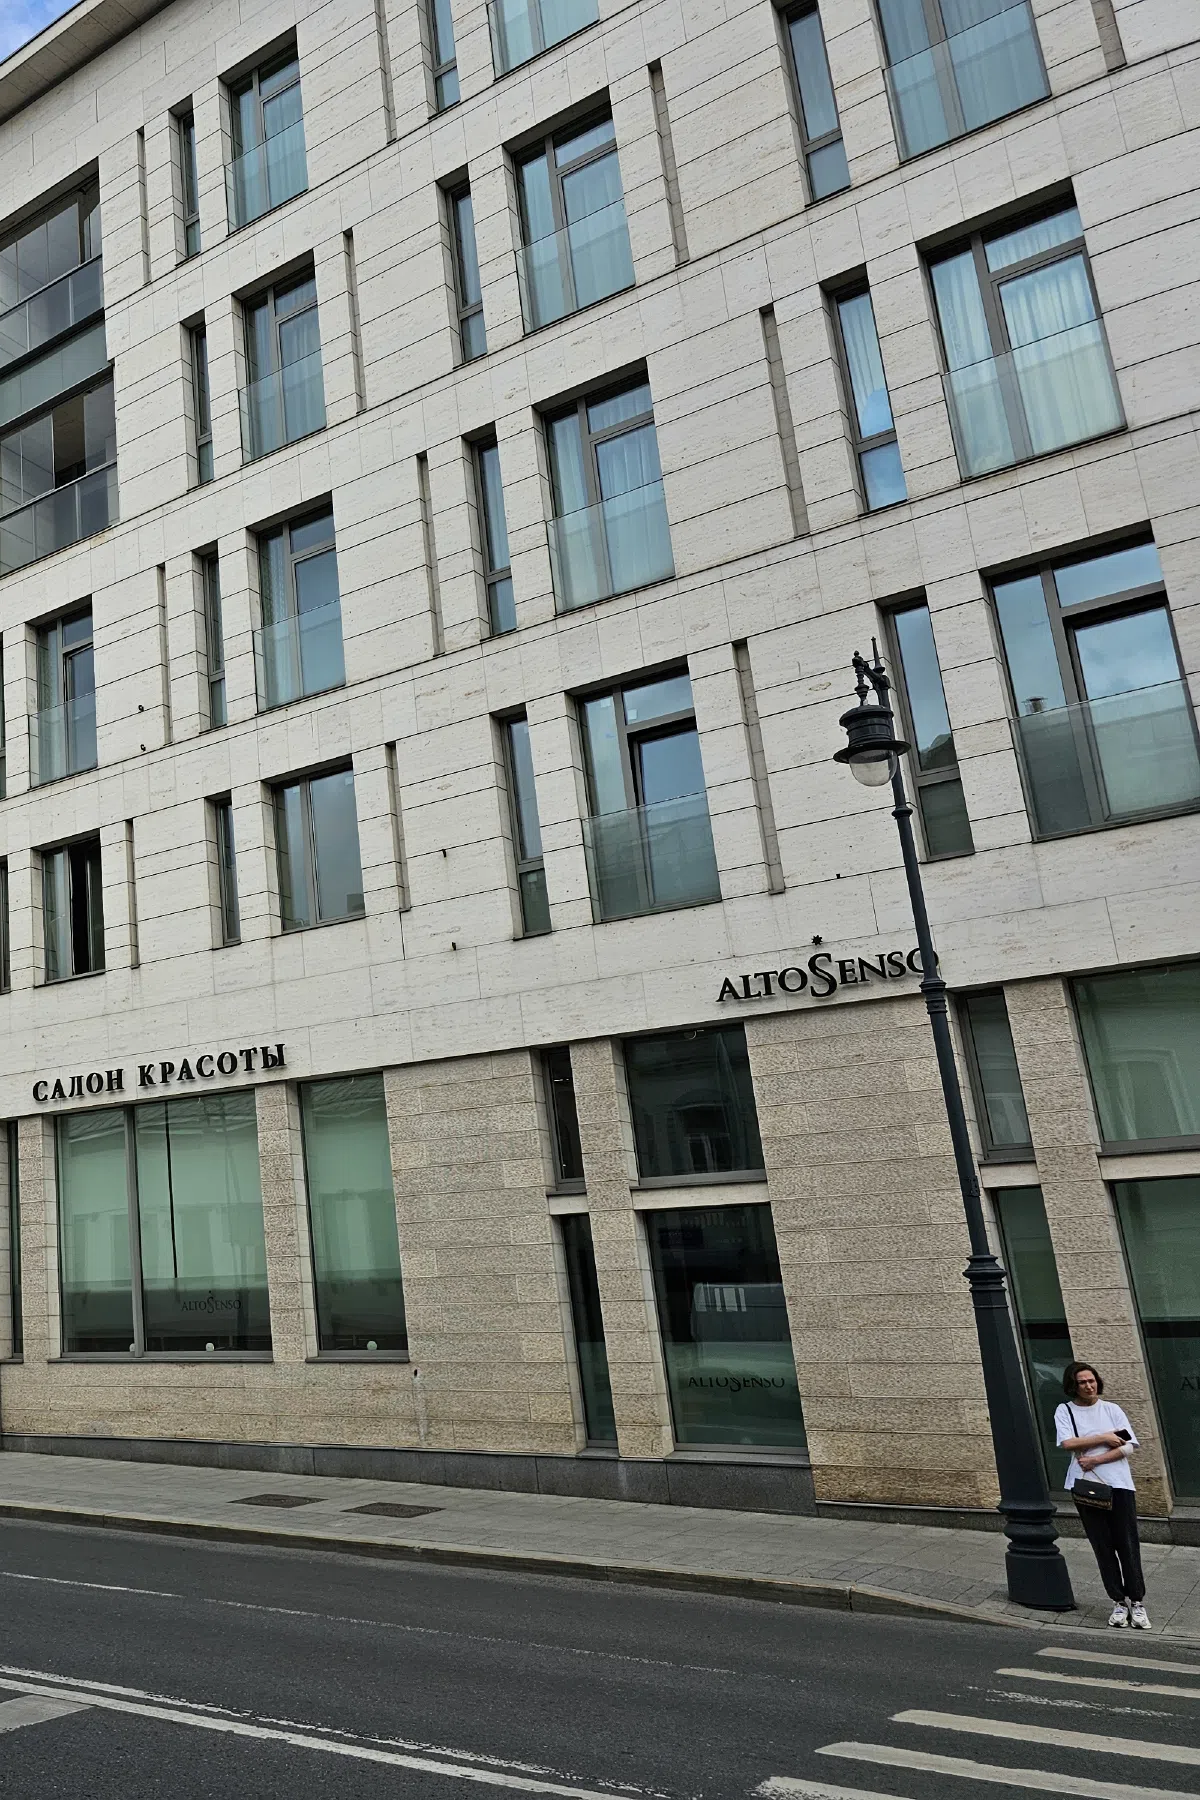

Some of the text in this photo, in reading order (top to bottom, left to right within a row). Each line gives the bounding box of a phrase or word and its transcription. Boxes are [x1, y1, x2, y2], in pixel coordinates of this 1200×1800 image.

[715, 947, 940, 1002] ALTOSENSO
[32, 1043, 288, 1102] САЛОН КРАСОТЫ
[182, 1297, 242, 1314] ALTOSENSO
